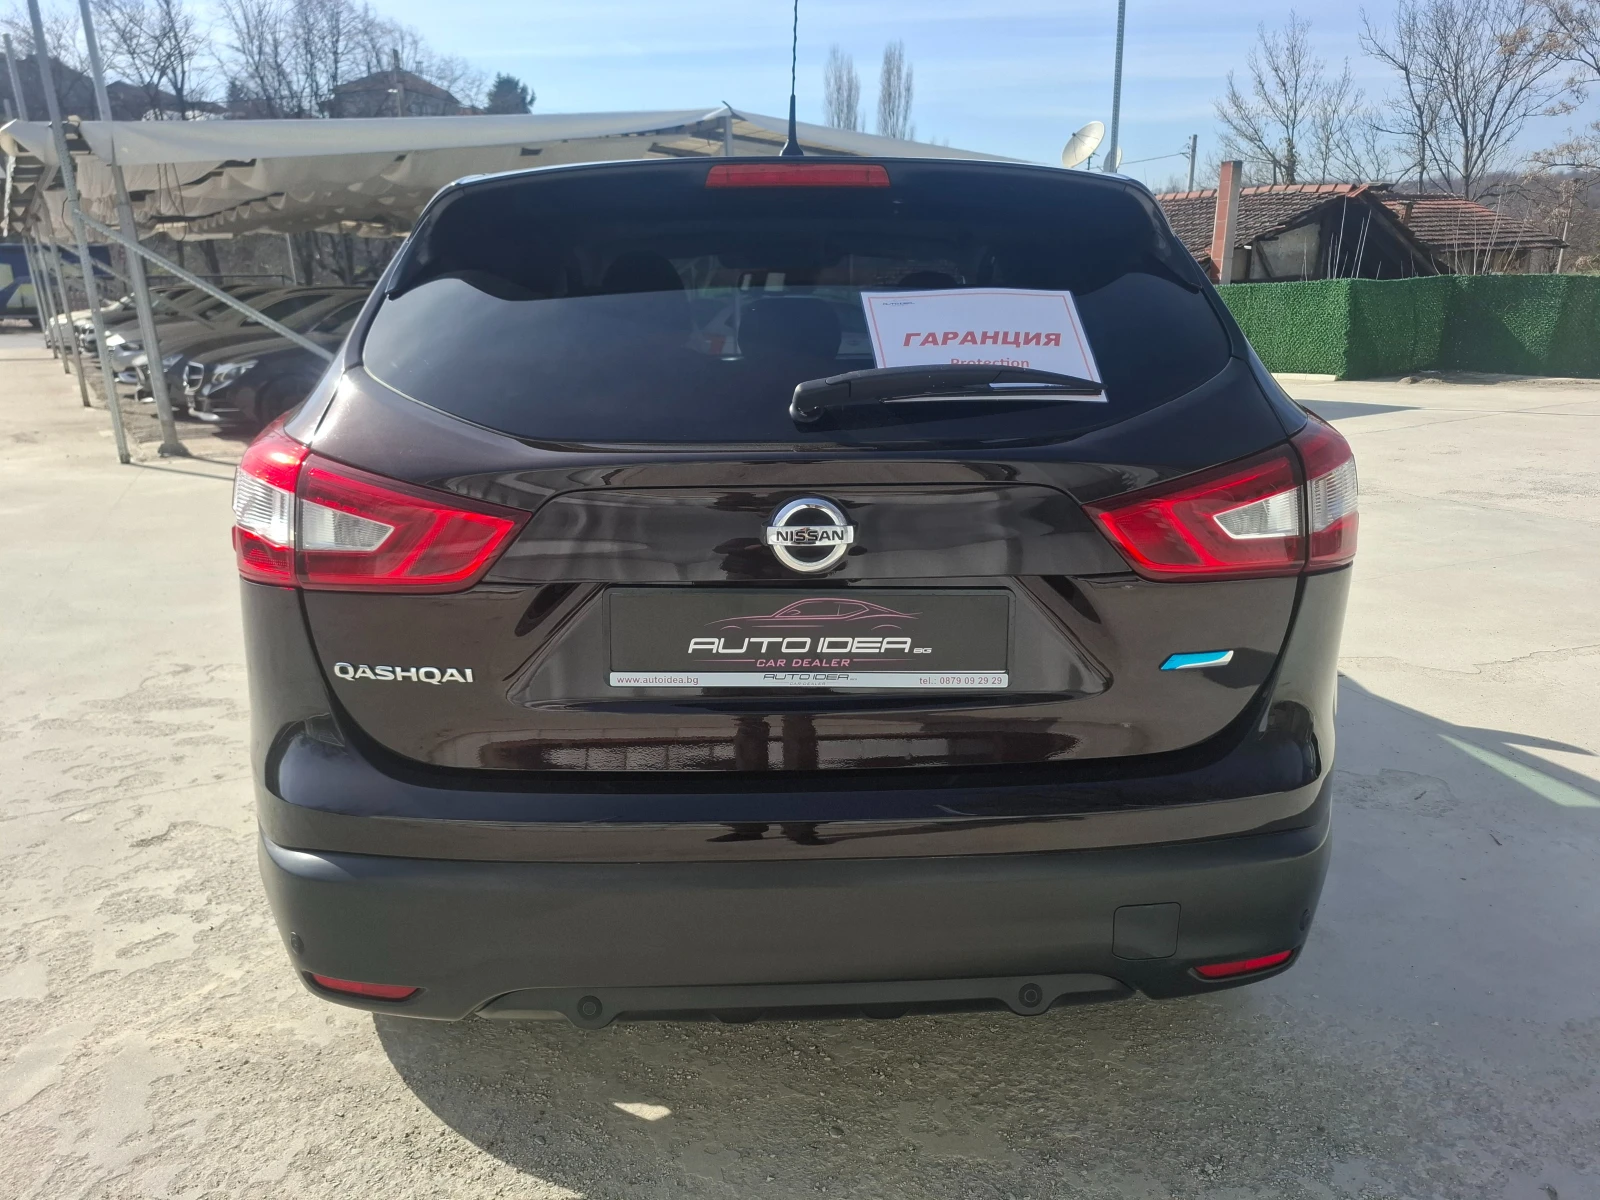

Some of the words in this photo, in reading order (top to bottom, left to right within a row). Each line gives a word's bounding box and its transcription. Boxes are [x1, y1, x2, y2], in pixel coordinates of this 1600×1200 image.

[903, 331, 1061, 348] ГАРАНЦИЯ
[776, 529, 844, 542] NISSAN
[688, 637, 811, 653] AUTO
[816, 637, 911, 653] IDEA
[756, 659, 786, 667] CAR
[792, 658, 850, 667] DEALER
[333, 662, 474, 685] QASHQAI
[616, 676, 699, 686] www.autoidea.bg
[919, 676, 937, 685] tel.:
[939, 676, 962, 685] 0879
[964, 676, 975, 685] 09
[977, 676, 989, 685] 29
[991, 676, 1003, 685] 29
